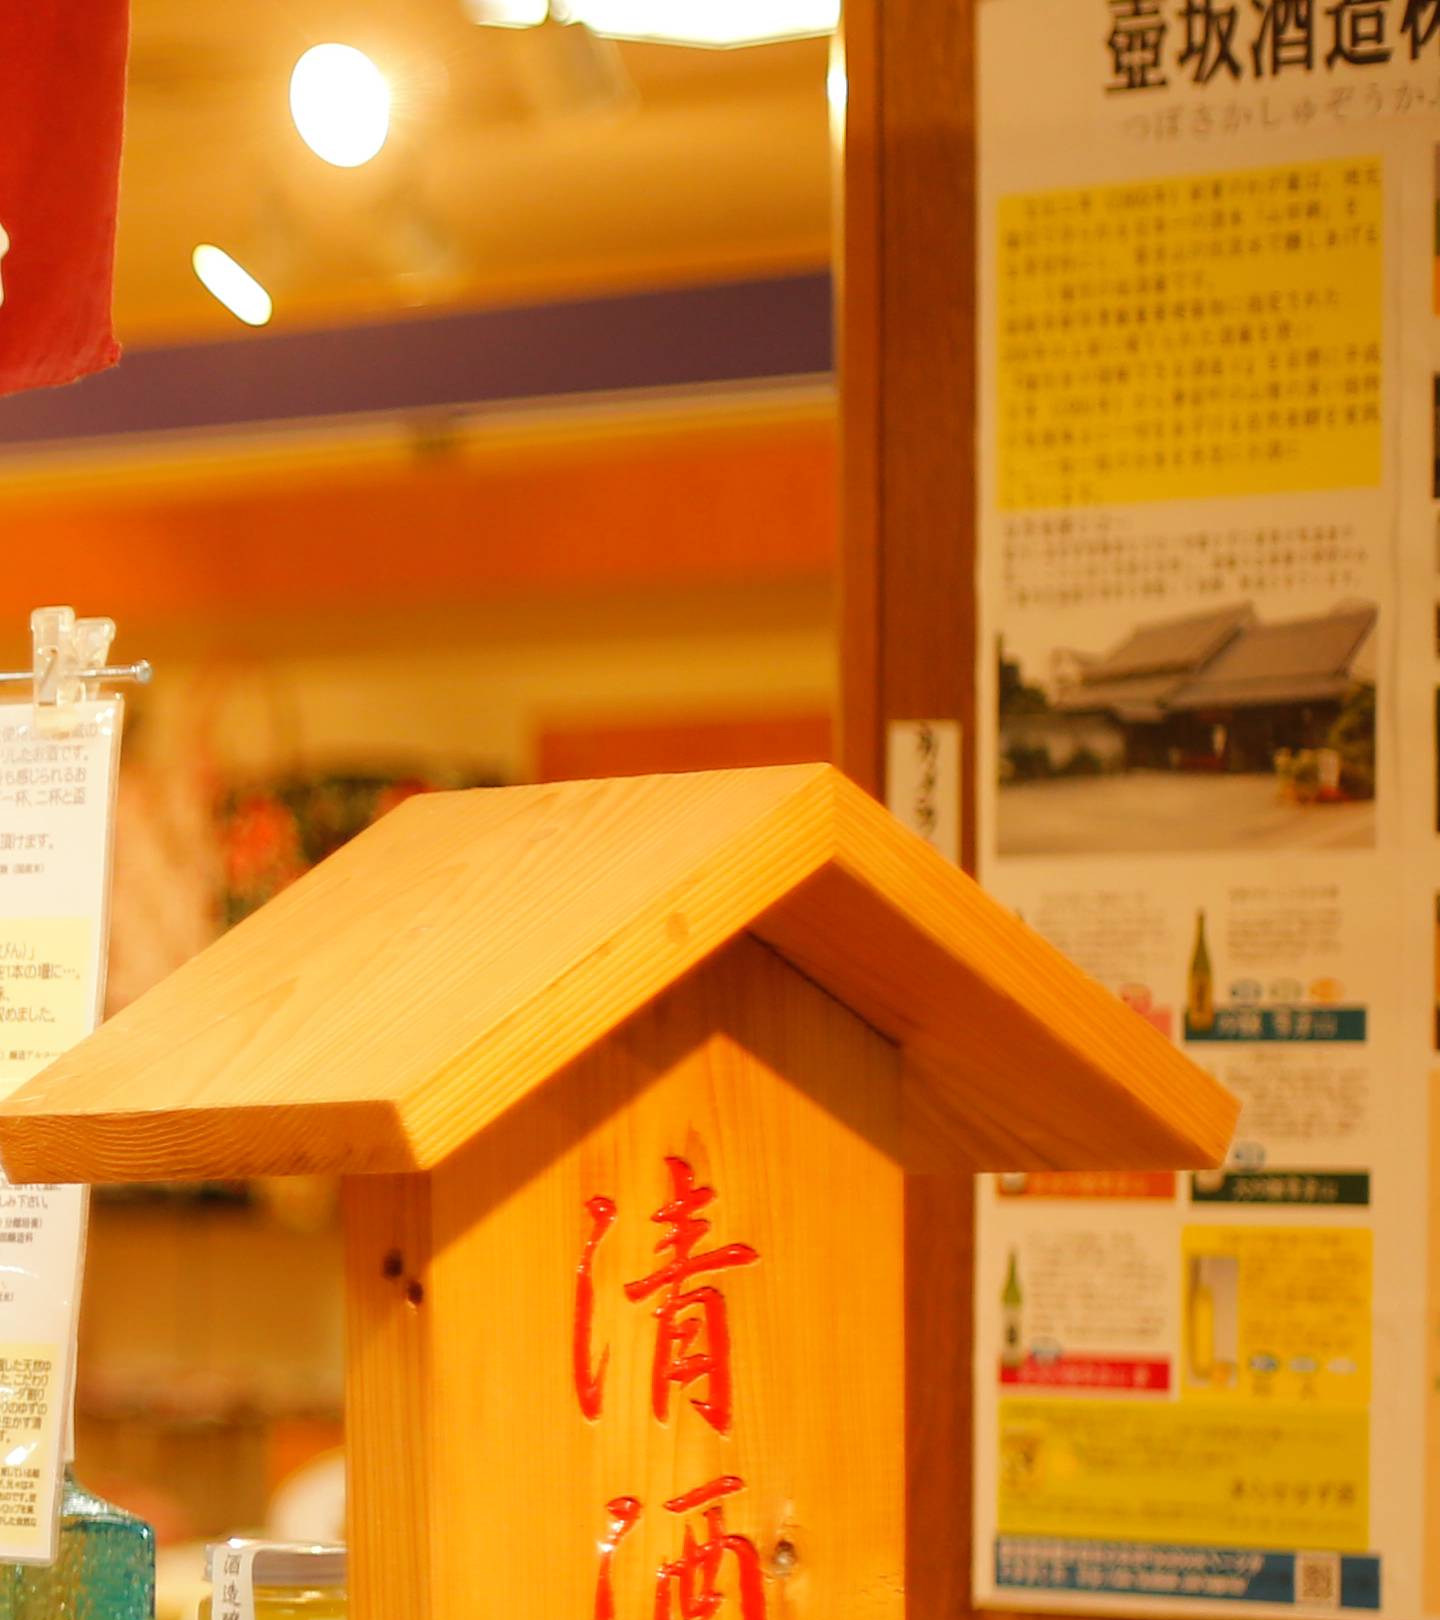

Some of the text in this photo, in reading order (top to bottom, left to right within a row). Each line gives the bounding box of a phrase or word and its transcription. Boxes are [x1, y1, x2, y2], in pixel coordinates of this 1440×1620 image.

[1124, 80, 1440, 140] つぼさかしゅぞうか
